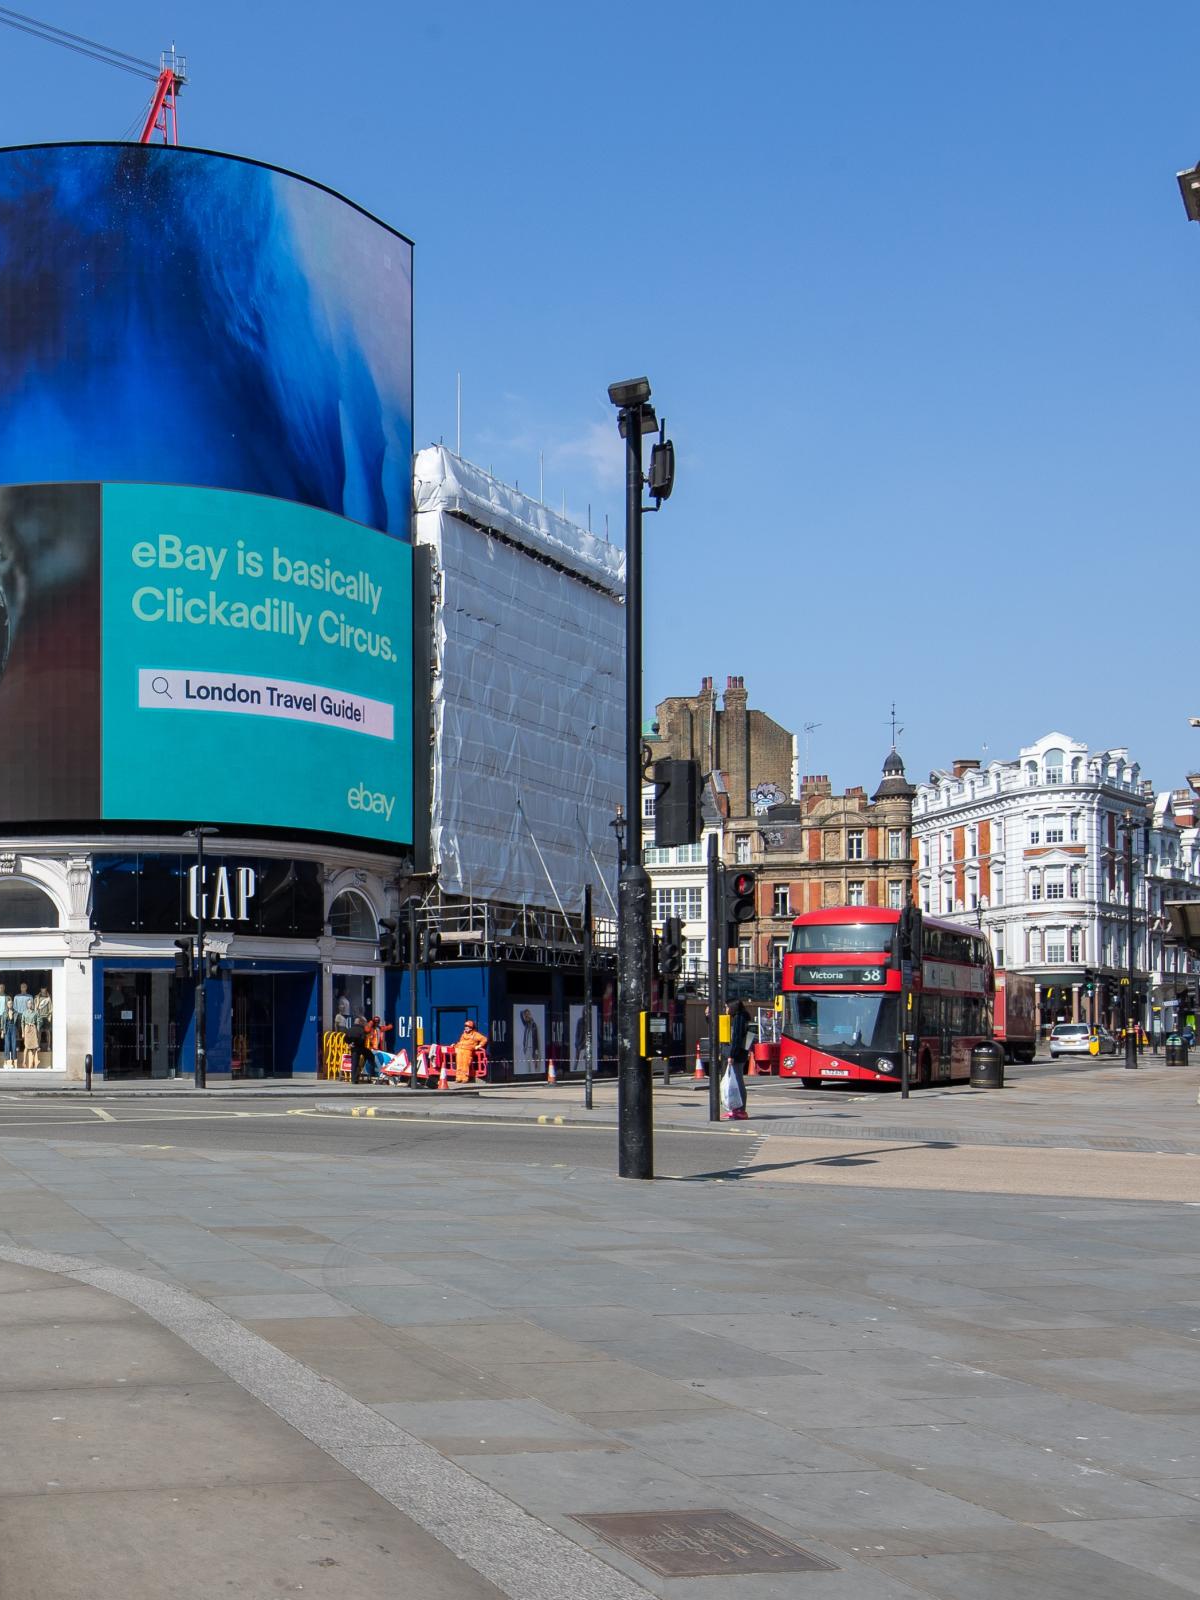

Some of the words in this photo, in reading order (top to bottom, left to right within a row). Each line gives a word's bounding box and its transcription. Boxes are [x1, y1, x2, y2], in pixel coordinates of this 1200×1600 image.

[131, 533, 228, 581] eBay
[236, 539, 264, 578] is
[272, 546, 383, 615] basically
[131, 586, 313, 646] Clickadilly
[318, 609, 398, 663] Circus.
[185, 679, 261, 705] London
[265, 686, 316, 713] Travel
[320, 695, 362, 722] Guide
[347, 782, 396, 822] ebay
[188, 865, 256, 921] GAP
[809, 970, 843, 979] Victoria
[862, 970, 881, 981] 38
[492, 1020, 507, 1042] GAP
